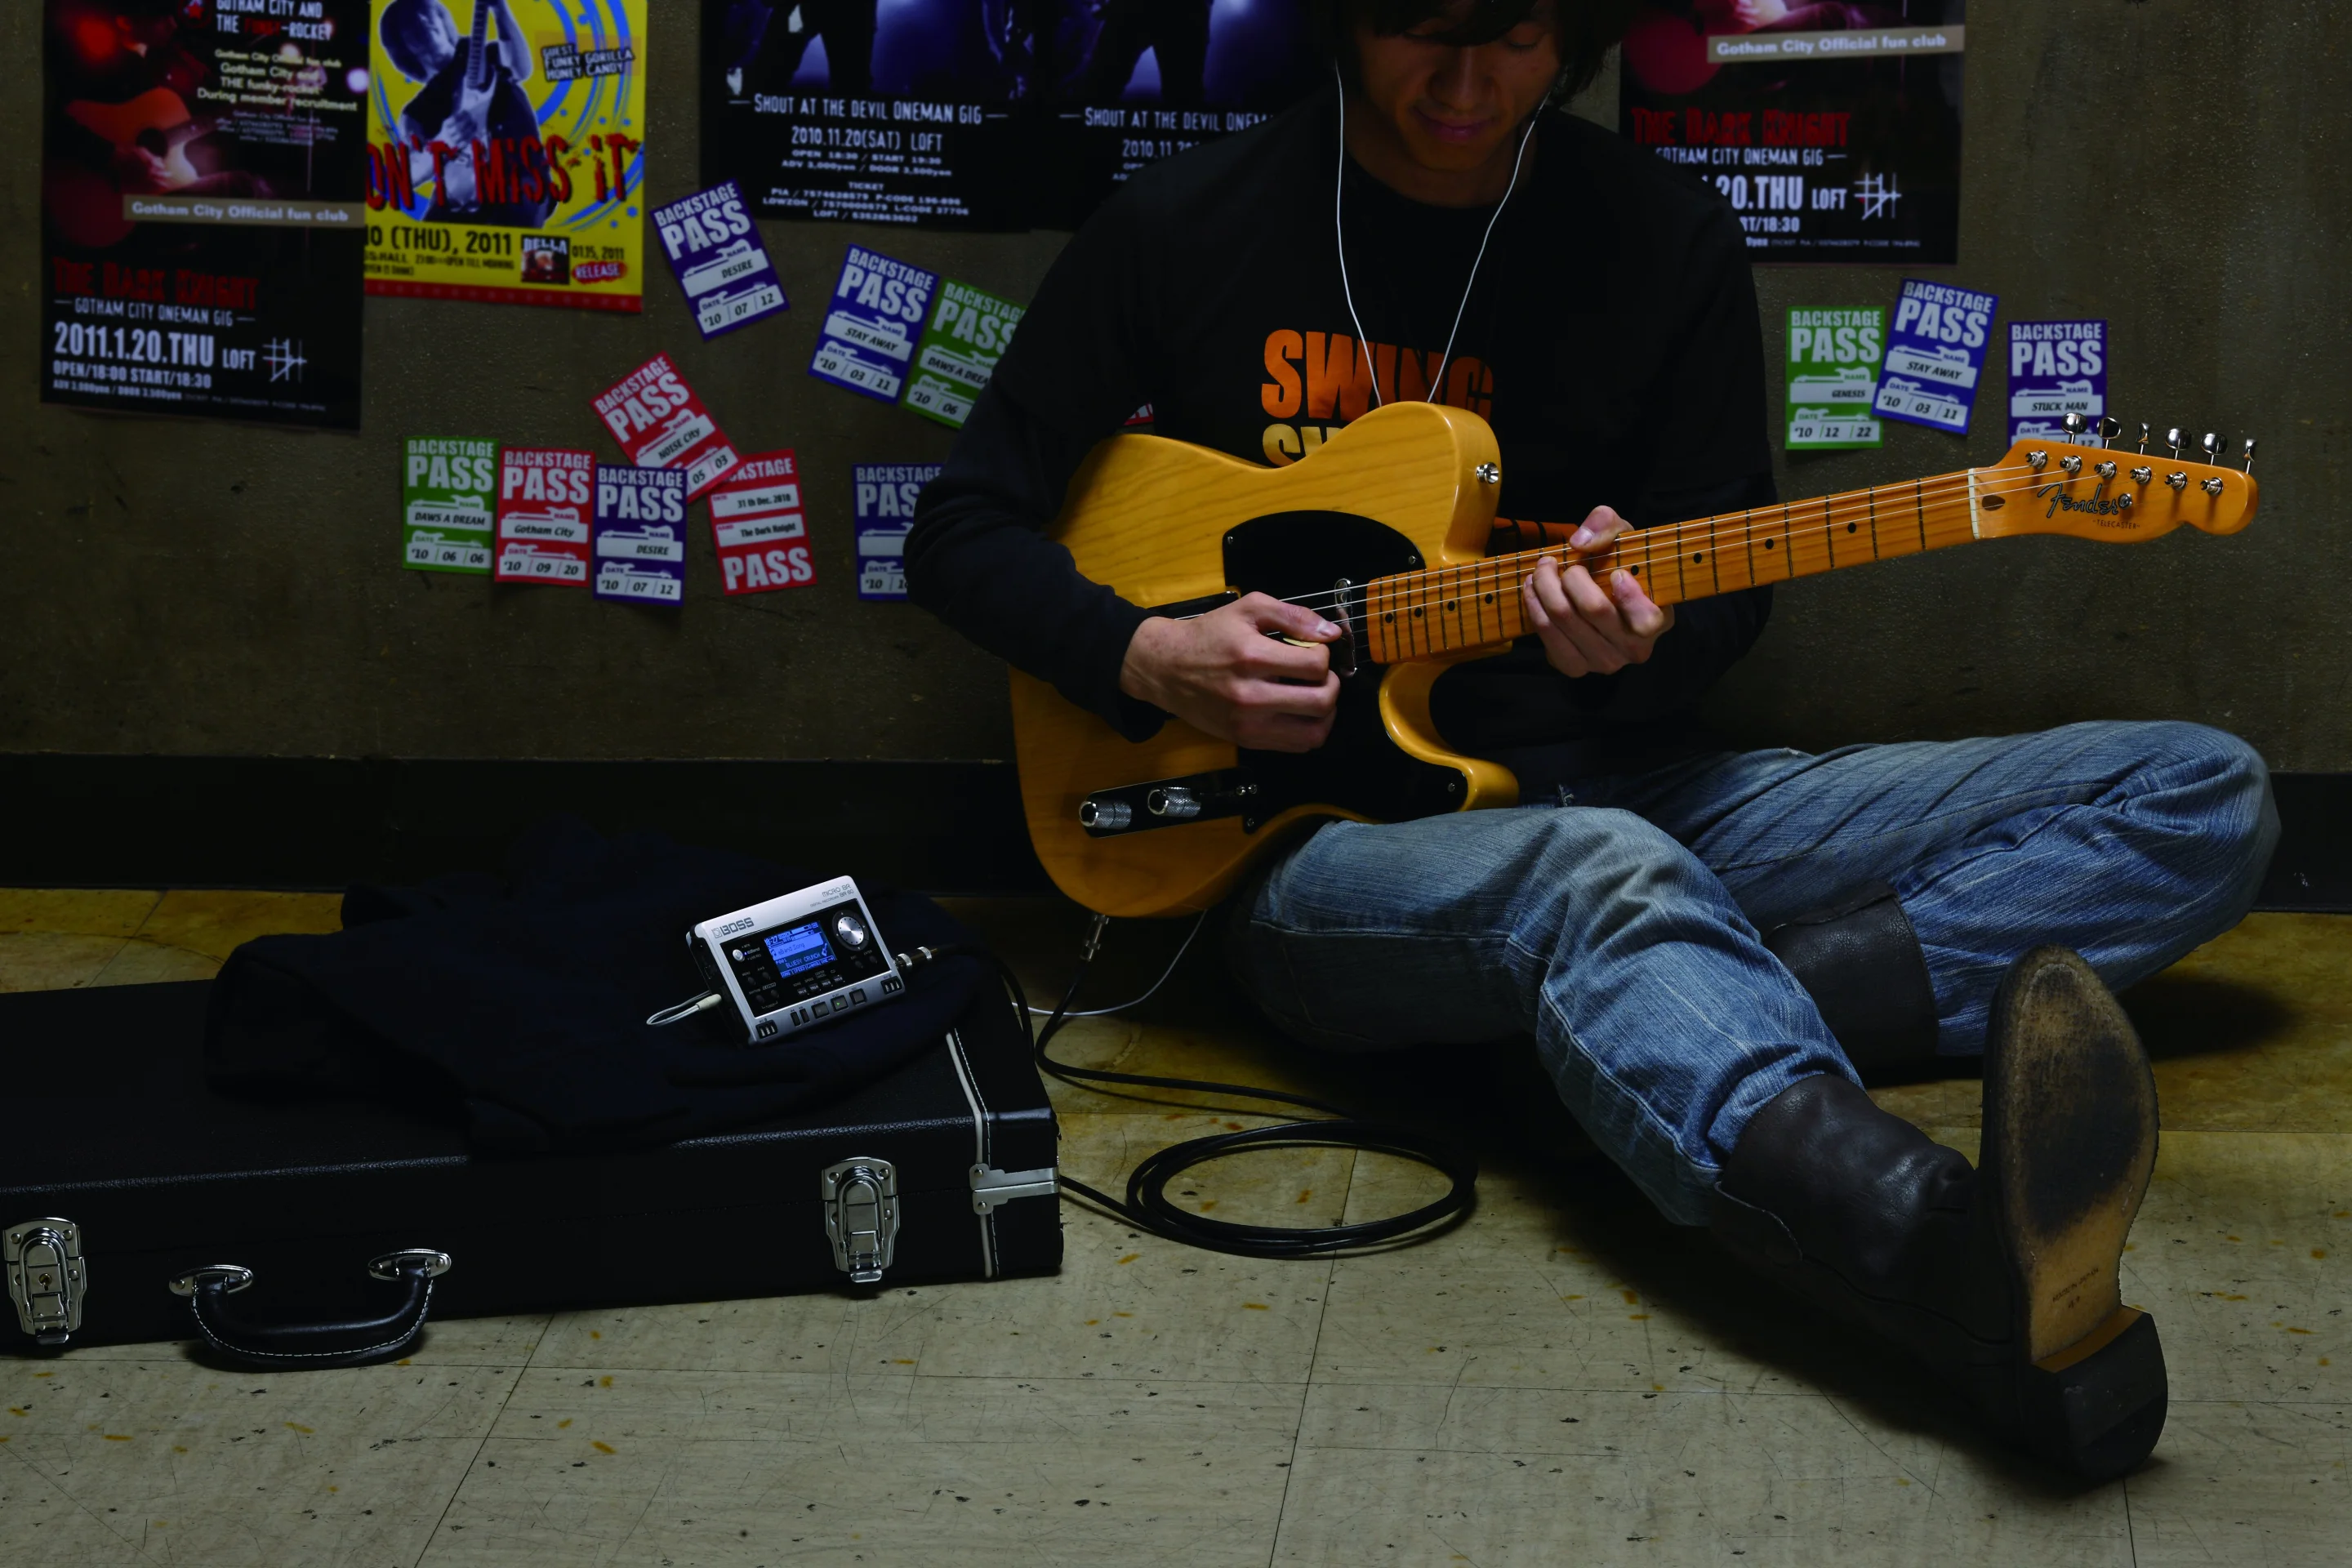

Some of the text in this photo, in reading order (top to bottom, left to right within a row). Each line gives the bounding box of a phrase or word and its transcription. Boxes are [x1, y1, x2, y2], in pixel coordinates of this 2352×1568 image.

[269, 0, 295, 16] CITY
[298, 2, 323, 18] AND
[216, 14, 240, 33] THE
[1717, 34, 1946, 56] Gotham City Official fun club
[546, 48, 635, 69] FUNKY GORILLA
[220, 62, 266, 76] Gotham
[270, 67, 293, 79] City
[546, 62, 623, 82] HONEY CANDY
[220, 76, 243, 89] THE
[197, 87, 358, 111] During member recruitment
[754, 92, 982, 125] SHOUT AT THE DEVIL ONEMAN GIG
[1085, 106, 1221, 131] SHOUT AT THE DEVIL
[1631, 107, 1851, 147] THE DARK KNIGHT
[791, 125, 943, 152] 2010.11.20(SAT) LOFT
[791, 149, 822, 158] OPEN
[828, 151, 858, 160] 18:30
[871, 154, 905, 163] START
[1712, 148, 1824, 166] CITY ONEMAN GIG
[653, 182, 738, 227] BACKSTAGE
[1811, 188, 1848, 210] LOFT
[132, 202, 349, 221] Gotham City Official fun club
[660, 199, 751, 261] PASS
[391, 227, 512, 256] (THU), 2011
[602, 247, 625, 260] 2011
[575, 263, 621, 279] RELEASE
[721, 260, 753, 278] DESIRE
[848, 247, 933, 291] BACKSTAGE
[53, 256, 260, 310] THE DARK KNIGHT
[836, 264, 927, 323] PASS
[943, 282, 1027, 321] BACKSTAG
[1903, 281, 1993, 314] BACKSTAGE
[74, 297, 234, 326] GOTHAM CITY ONEMAN GIG
[704, 293, 774, 327] '10 07 12
[1791, 310, 1881, 327] BACKSTAGE
[1895, 296, 1988, 348] PASS
[2011, 323, 2102, 341] BACKSTAGE
[54, 321, 256, 371] 2011.1.20.THU LOFT
[845, 327, 898, 352] STAY AWAY
[1791, 327, 1881, 363] PASS
[929, 358, 965, 377] DAWS A
[2011, 340, 2102, 376] PASS
[53, 360, 212, 389] OPEN/18:00 START/18:30
[820, 358, 890, 390] '10 03 11
[1261, 328, 1494, 423] SWING
[1907, 361, 1962, 380] STAY AWAY
[594, 356, 670, 415] BACKSTAGE
[604, 372, 690, 443] PASS
[913, 390, 958, 415] '10 06
[1883, 394, 1958, 420] '10 03 11
[2032, 402, 2087, 411] STUCK MAN
[1794, 427, 1872, 438] '10 12 22
[408, 439, 494, 457] BACKSTAGE
[658, 439, 684, 460] NOISE
[505, 451, 591, 470] BACKSTAGE
[693, 455, 728, 484] 05 03
[408, 455, 494, 492] PASS
[598, 467, 683, 488] BACKSTAGE
[502, 466, 590, 505] PASS
[598, 483, 684, 523] PASS
[773, 493, 791, 503] 2010
[2038, 483, 2118, 518] Fender
[415, 512, 485, 526] DAWS A DREAM
[741, 523, 796, 537] The Dark Knight
[514, 524, 574, 538] Gotham City
[412, 548, 484, 564] '10 06 06
[636, 545, 669, 556] DESIRE
[504, 561, 579, 575] '10 09 20
[722, 546, 813, 590] PASS
[602, 580, 673, 595] '10 07 12
[866, 579, 883, 589] '10
[822, 887, 840, 897] MICRO
[719, 917, 754, 936] BOSS
[786, 952, 821, 969] BLUESY CRUNCH
